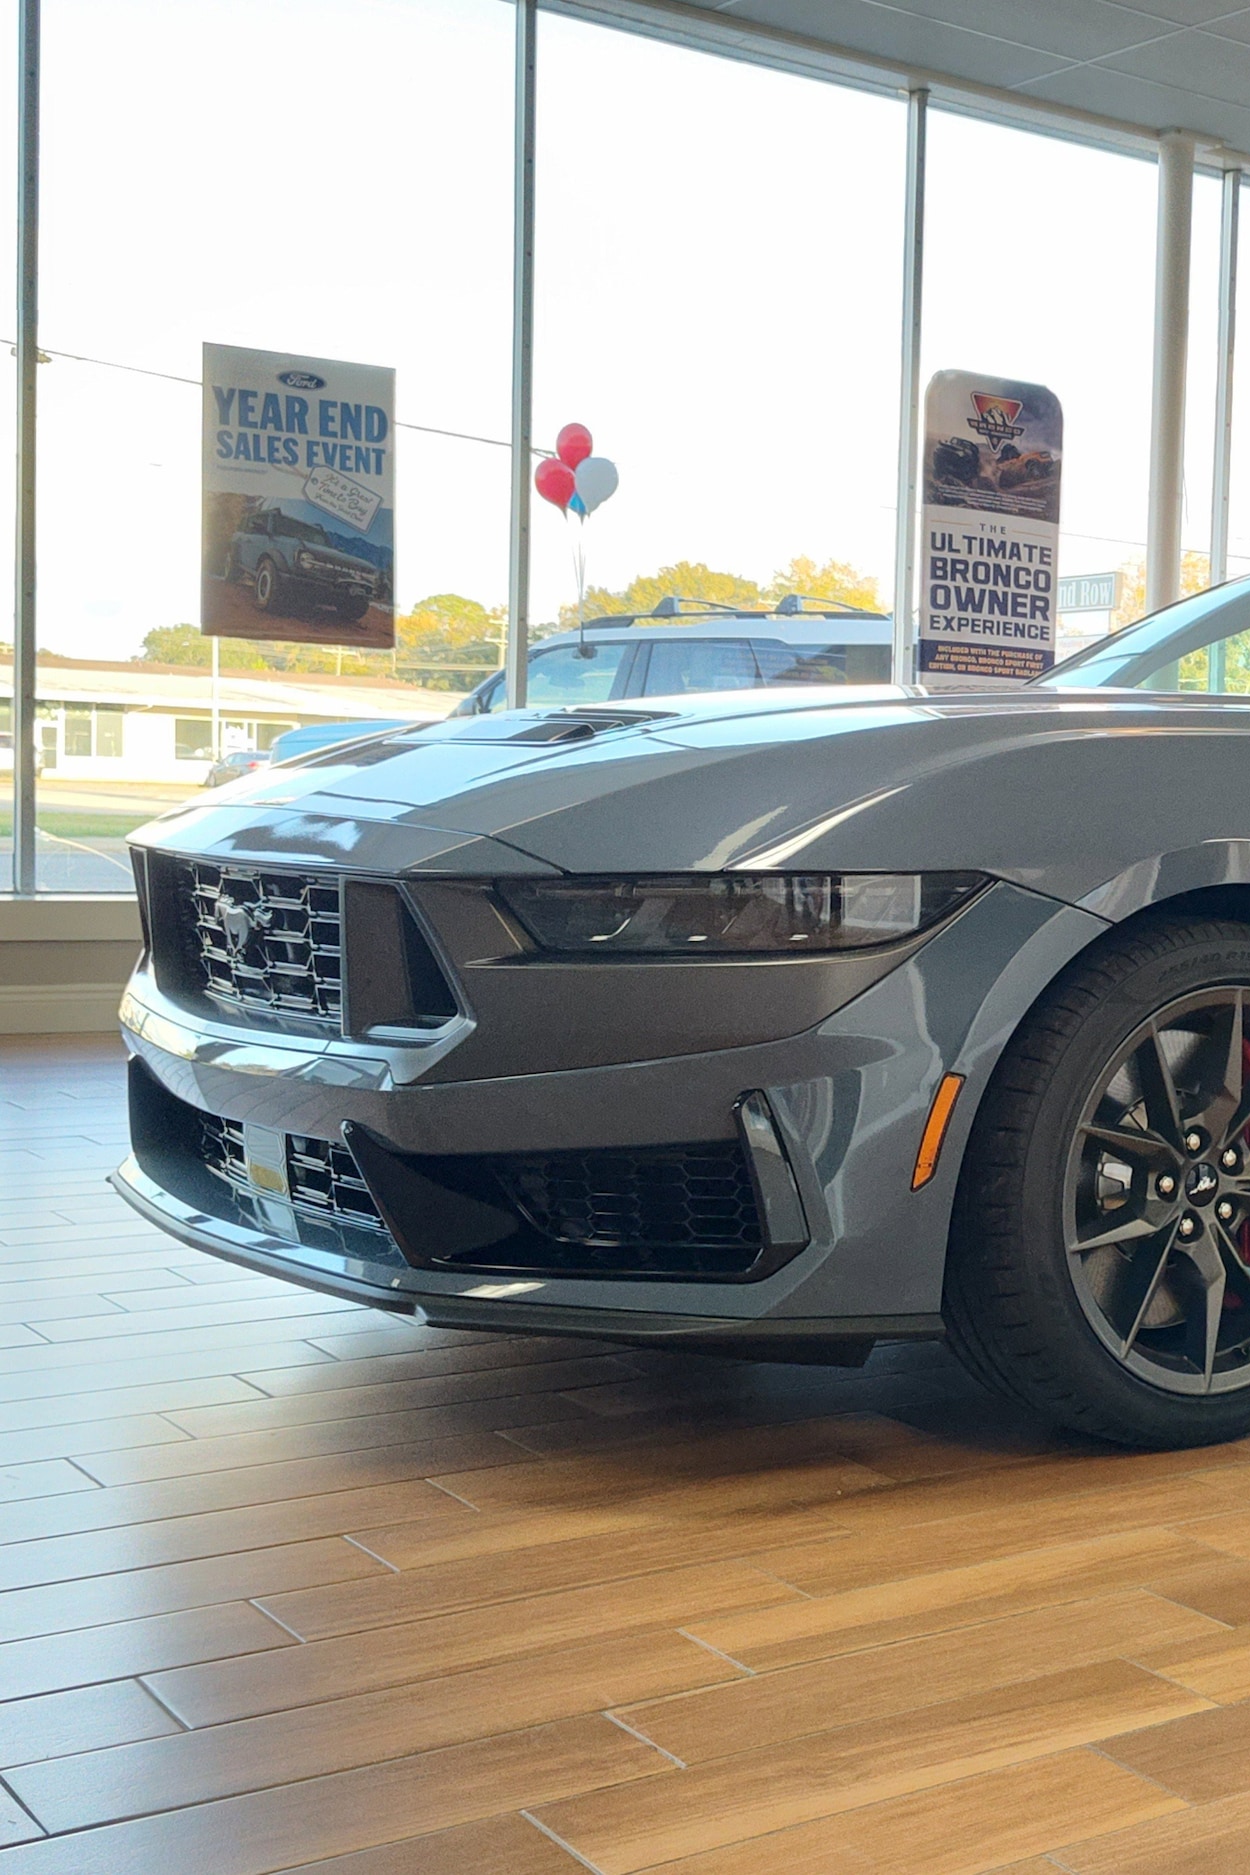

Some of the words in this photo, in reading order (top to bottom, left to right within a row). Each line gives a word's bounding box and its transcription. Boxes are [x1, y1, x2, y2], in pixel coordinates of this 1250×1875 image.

[212, 385, 309, 435] YEAR
[318, 399, 388, 444] END
[216, 430, 299, 467] SALES
[306, 440, 386, 475] EVENT
[979, 523, 1007, 535] THE
[930, 531, 1052, 566] ULTIMATE
[930, 556, 1051, 593] BRONCO
[930, 584, 1050, 622] OWNER
[1079, 580, 1111, 607] Row
[930, 614, 1050, 641] EXPERIENCE
[987, 649, 1000, 657] THE
[1001, 650, 1033, 660] PURCHASE
